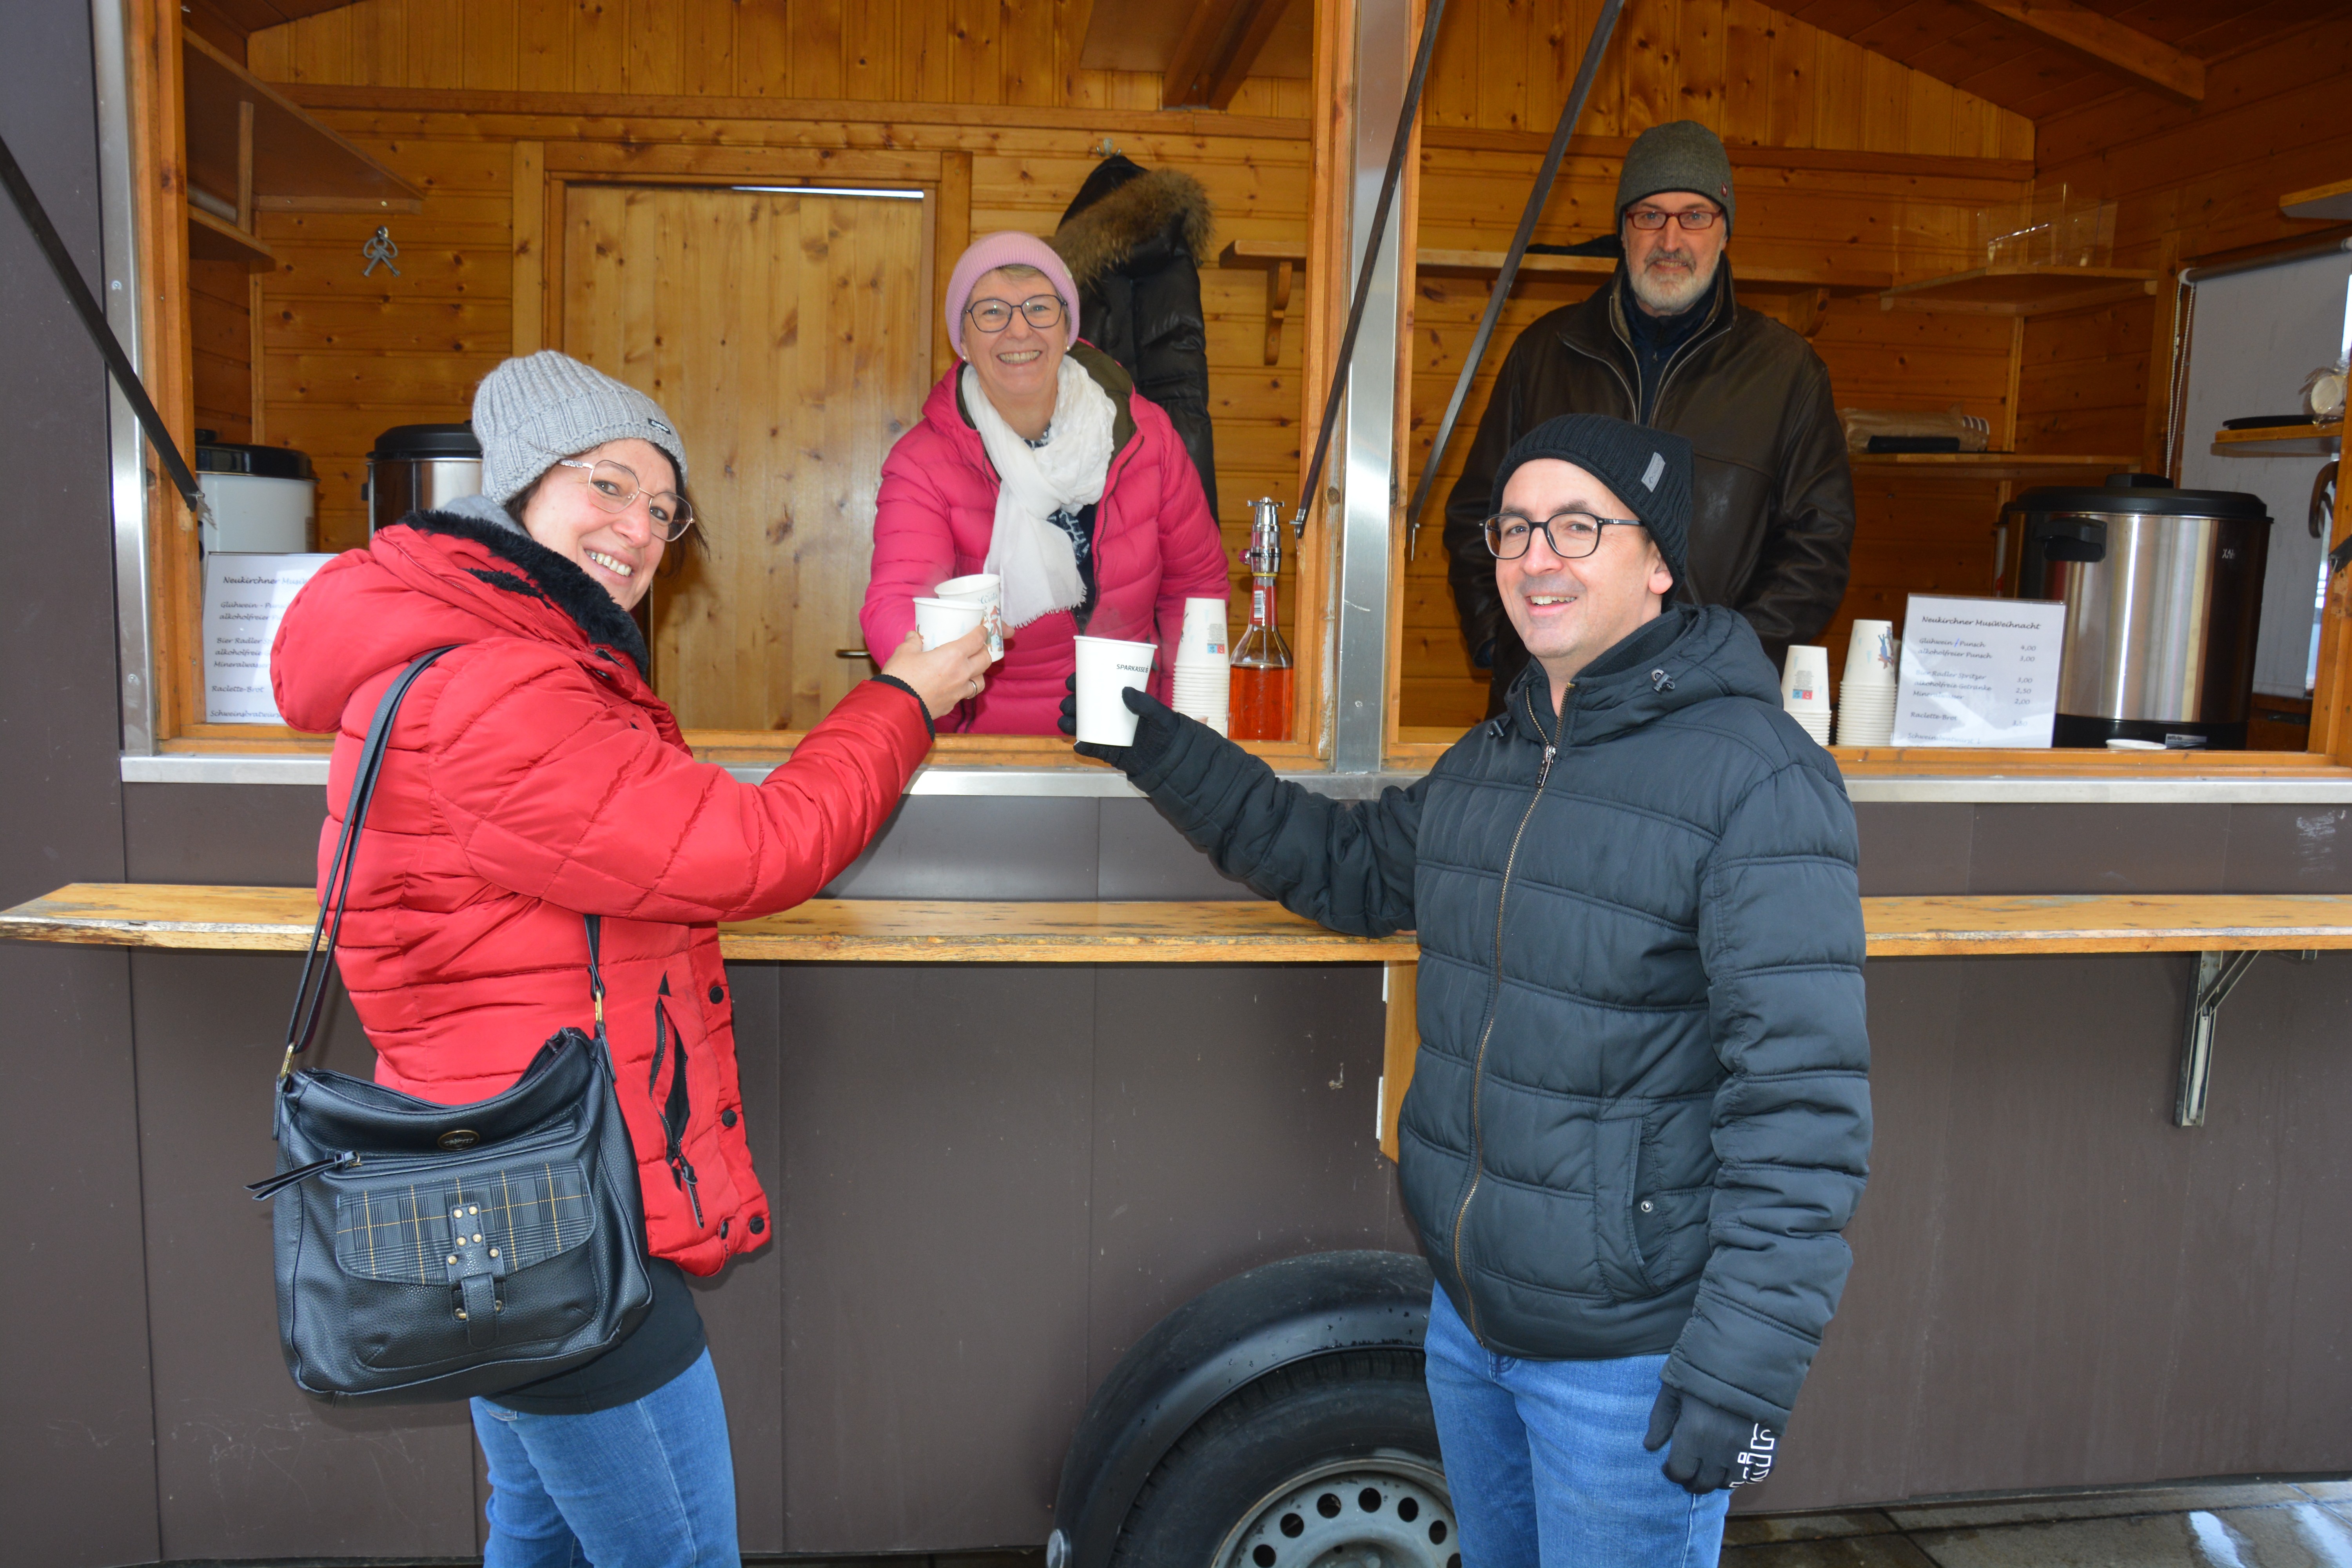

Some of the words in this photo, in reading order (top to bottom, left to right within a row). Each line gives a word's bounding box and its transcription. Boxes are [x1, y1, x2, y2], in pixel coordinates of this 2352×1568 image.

[1922, 616, 1974, 625] Neukirchner
[1116, 664, 1145, 673] SPARKASSE
[1915, 680, 1957, 689] alkoholfreie
[1910, 712, 1957, 721] Raclette-Brot
